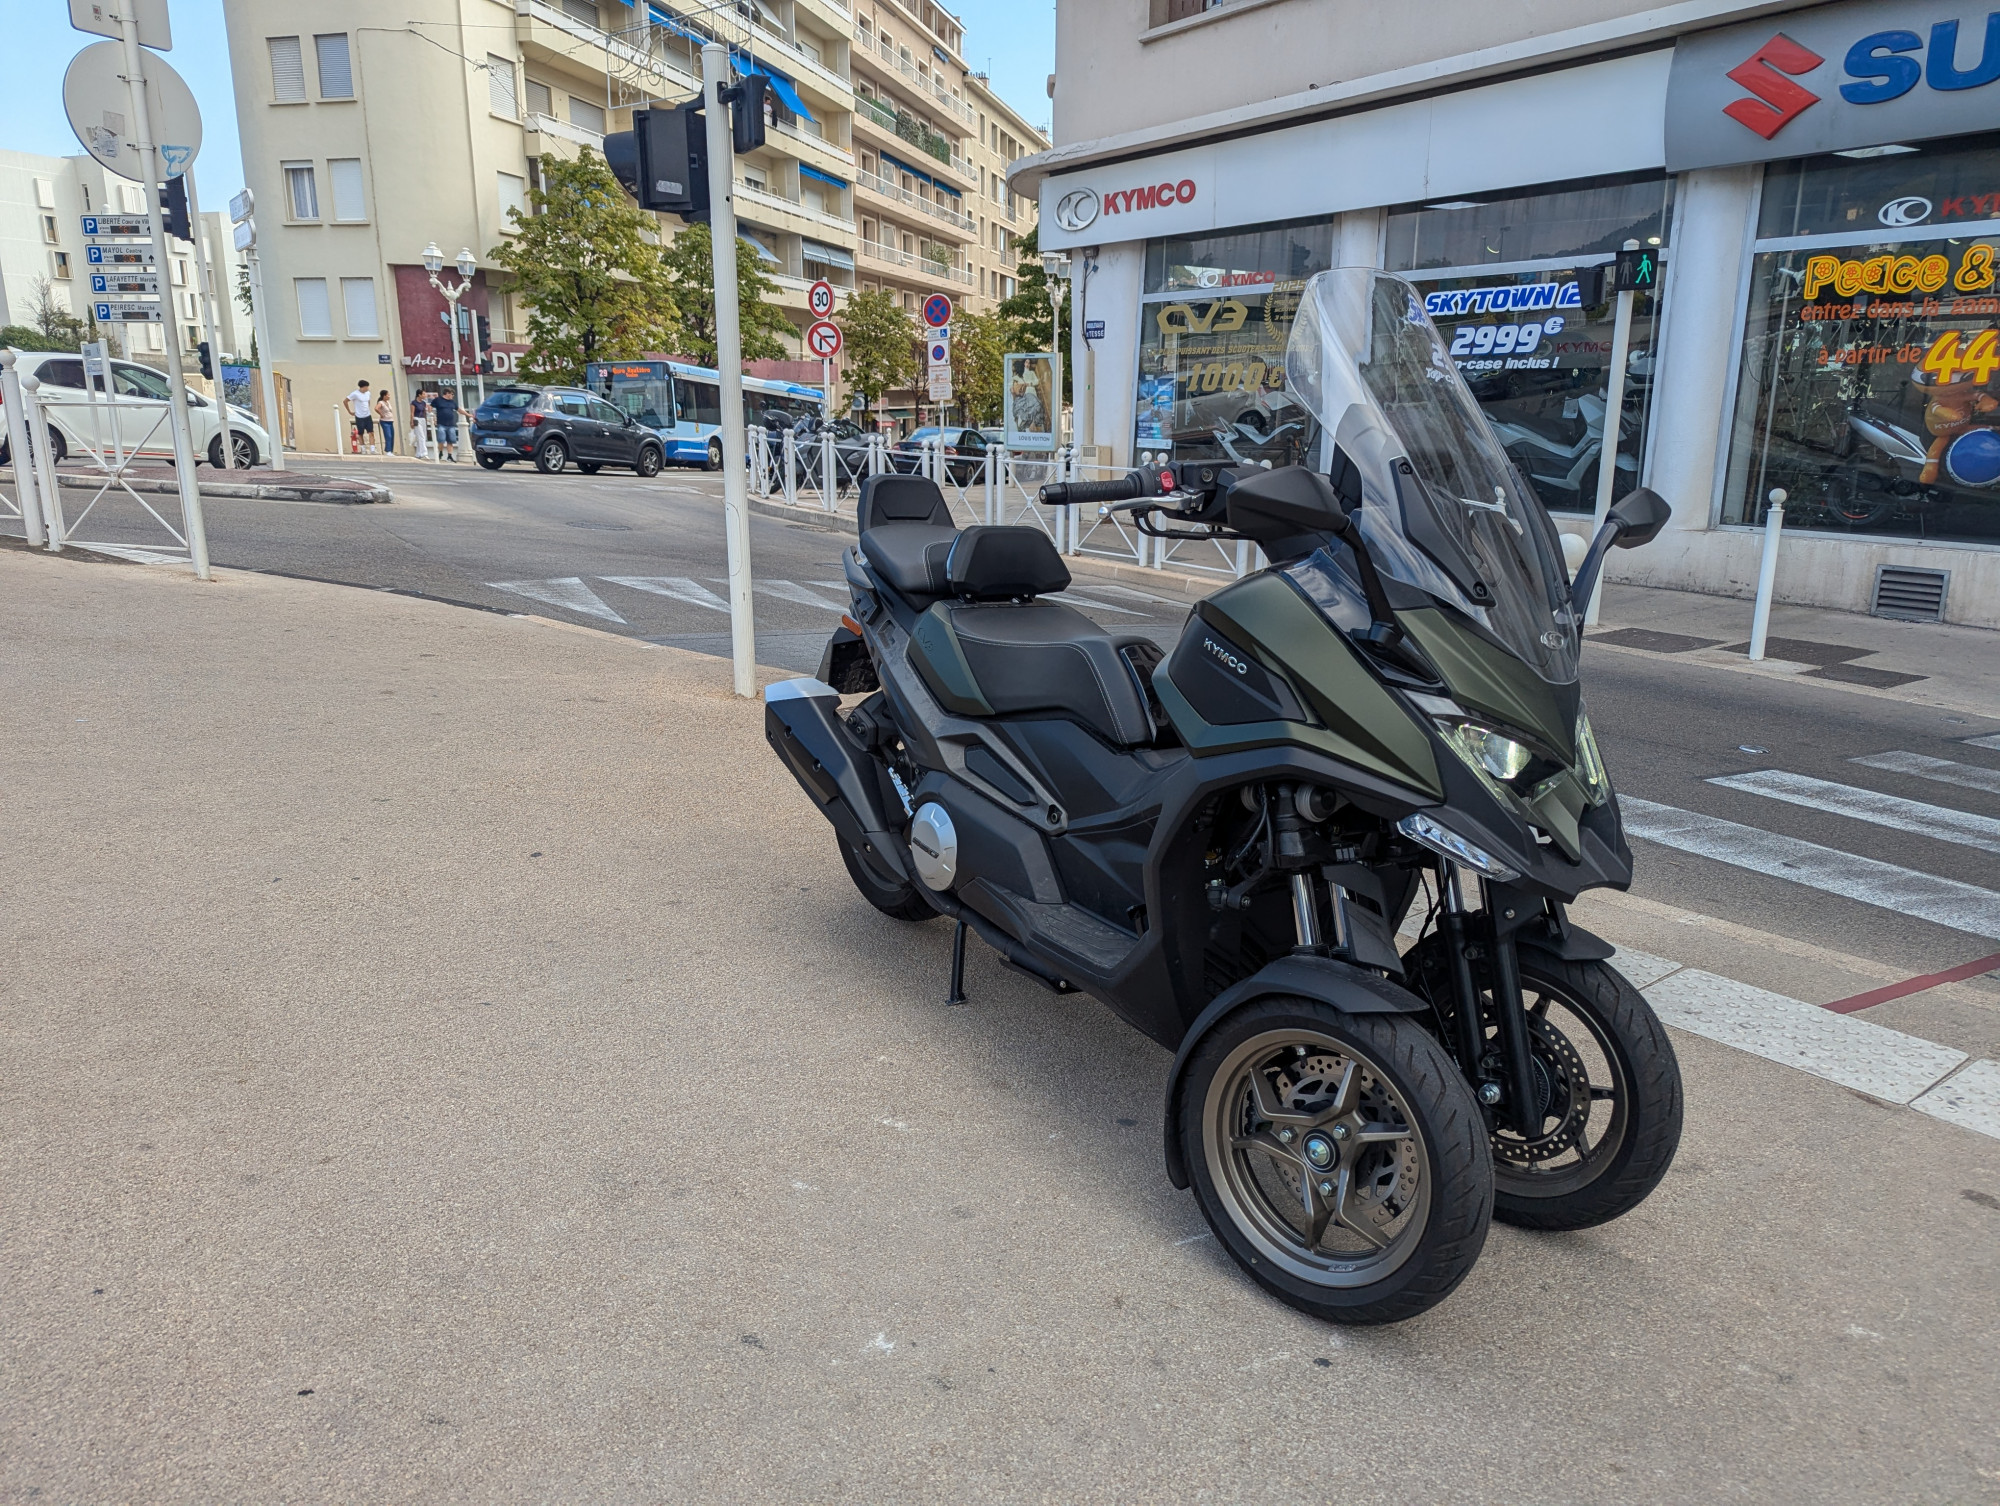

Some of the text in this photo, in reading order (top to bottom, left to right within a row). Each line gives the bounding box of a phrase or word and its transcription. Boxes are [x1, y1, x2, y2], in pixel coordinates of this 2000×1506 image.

[1839, 12, 2000, 105] SU
[1103, 179, 1197, 216] KYMCO
[102, 246, 124, 254] MAYOL
[106, 275, 139, 283] LAFAYETTE
[1221, 270, 1275, 288] KYMCO
[1804, 243, 1995, 299] Peace &
[110, 303, 136, 311] PEIRESC
[815, 291, 829, 308] 30
[1425, 283, 1560, 316] SKYTOWN
[1557, 281, 1582, 309] 12
[1800, 296, 2000, 321] entrez dans la gam
[1157, 300, 1249, 335] CV3
[1556, 341, 1613, 354] KYMC
[1835, 346, 1892, 365] partir
[1896, 343, 1922, 363] de
[1505, 356, 1551, 369] inclus
[599, 369, 608, 377] 29
[1203, 637, 1248, 675] KYMCO
